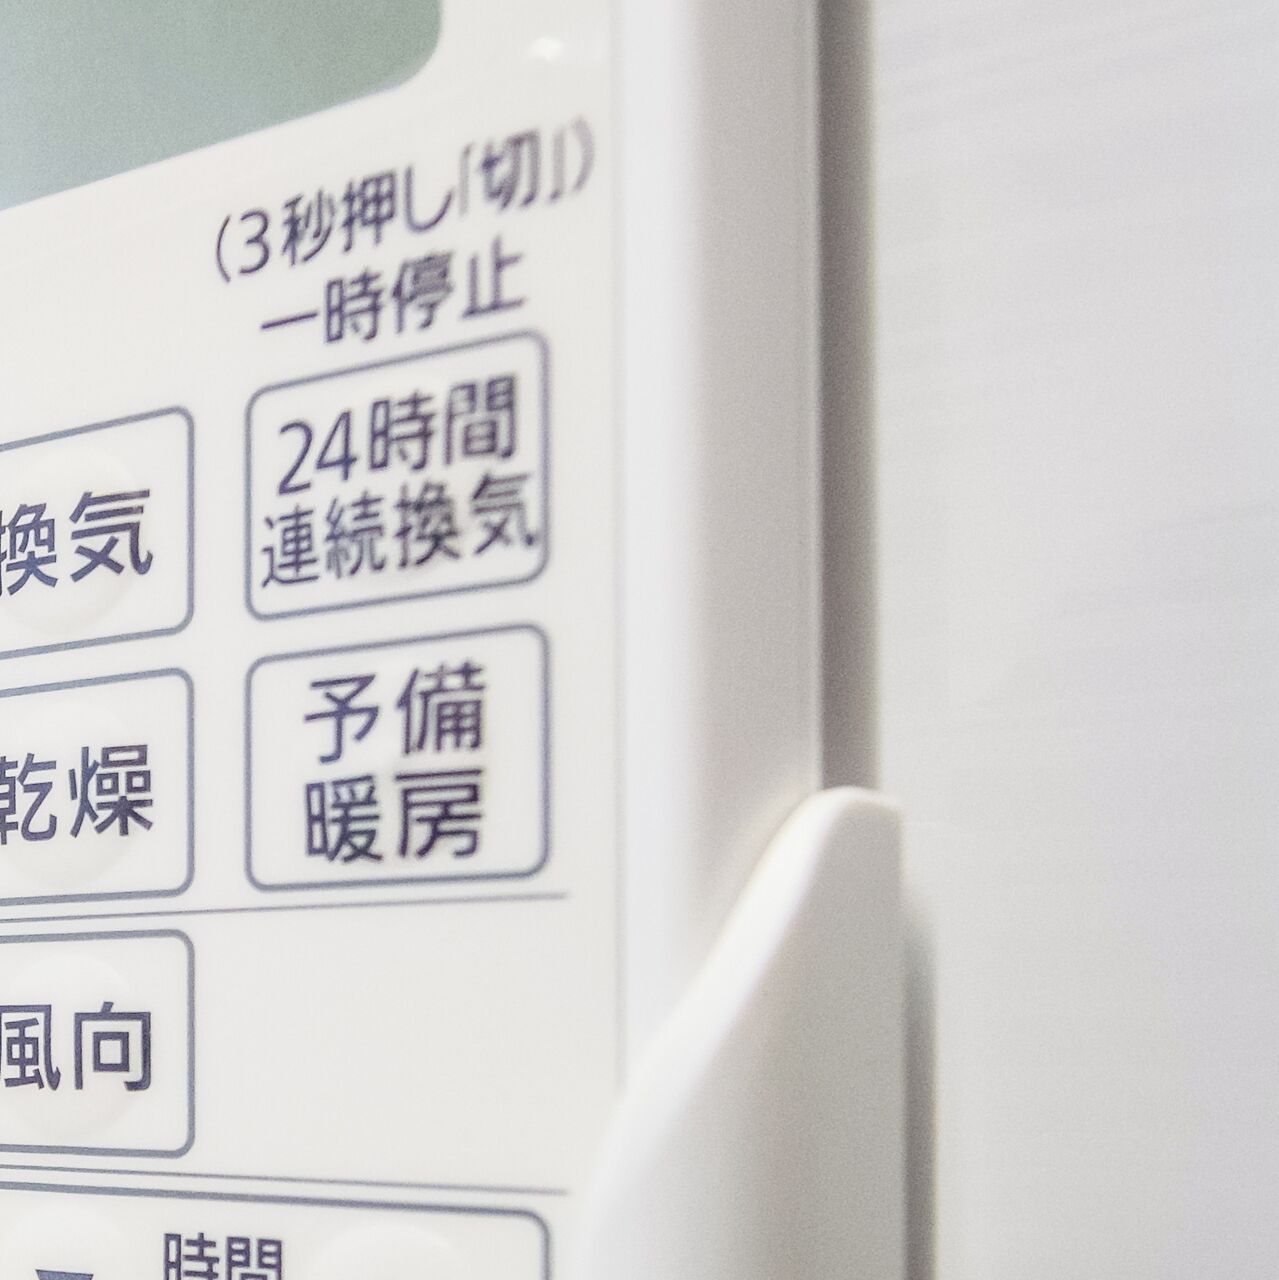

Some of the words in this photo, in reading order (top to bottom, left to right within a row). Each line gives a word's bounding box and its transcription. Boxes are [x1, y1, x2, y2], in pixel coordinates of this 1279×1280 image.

[259, 233, 528, 346] 一時停止
[276, 373, 518, 496] 24時間
[260, 470, 540, 588] 連続換気
[303, 658, 486, 764] 予備
[304, 767, 484, 864] 暖房
